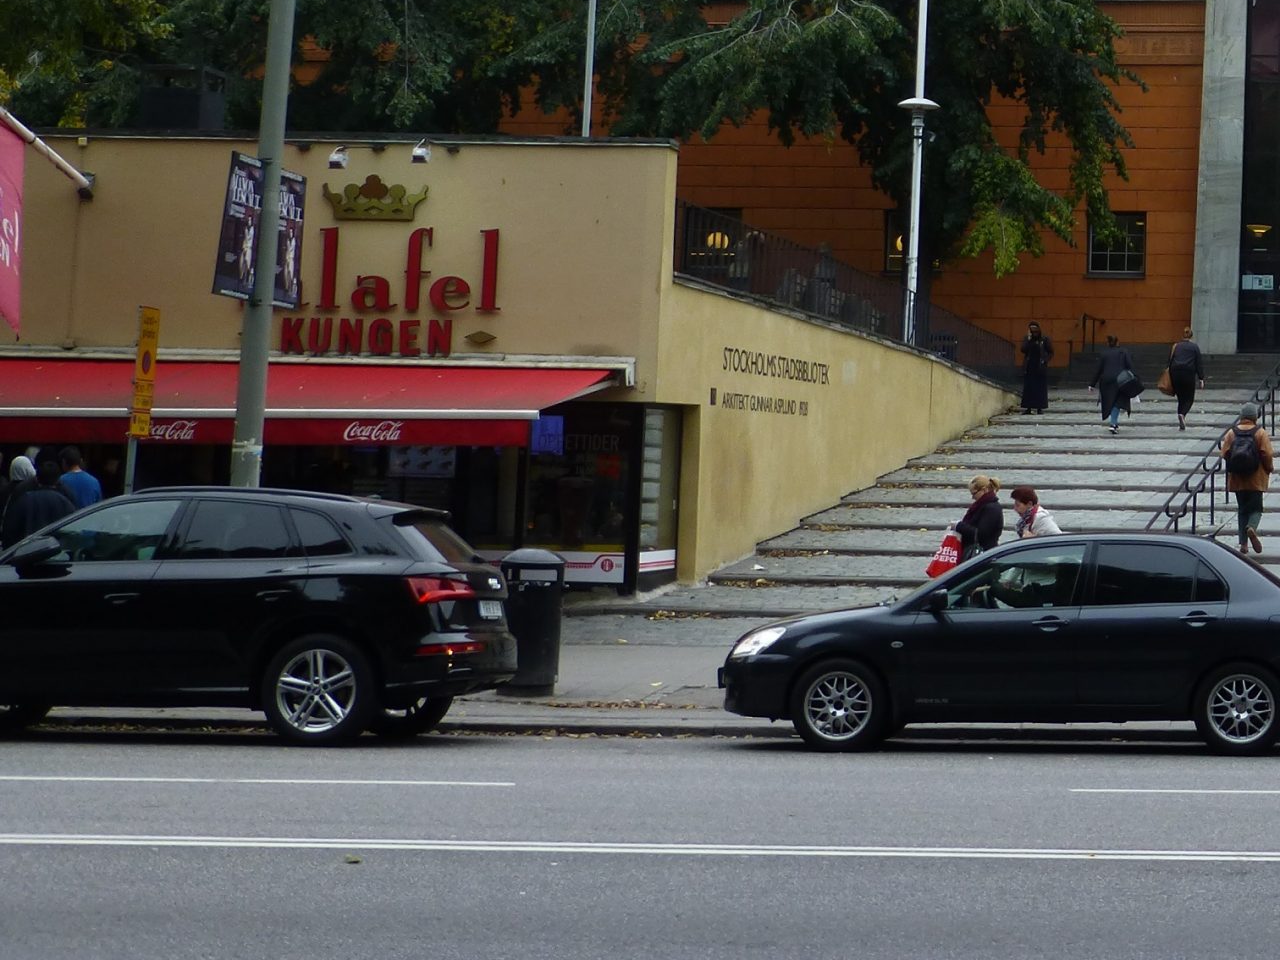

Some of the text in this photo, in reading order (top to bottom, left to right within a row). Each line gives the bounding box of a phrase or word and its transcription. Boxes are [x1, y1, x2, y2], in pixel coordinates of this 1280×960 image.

[298, 226, 502, 313] lafel
[280, 317, 453, 357] KUNGEN
[723, 347, 829, 384] STOCKHOLMS STADSBIBLIOTEK
[722, 393, 749, 410] ARKITEKT
[750, 395, 773, 412] GUNNAR
[774, 399, 796, 415] ASPLUND
[343, 420, 404, 441] Coca-Cola
